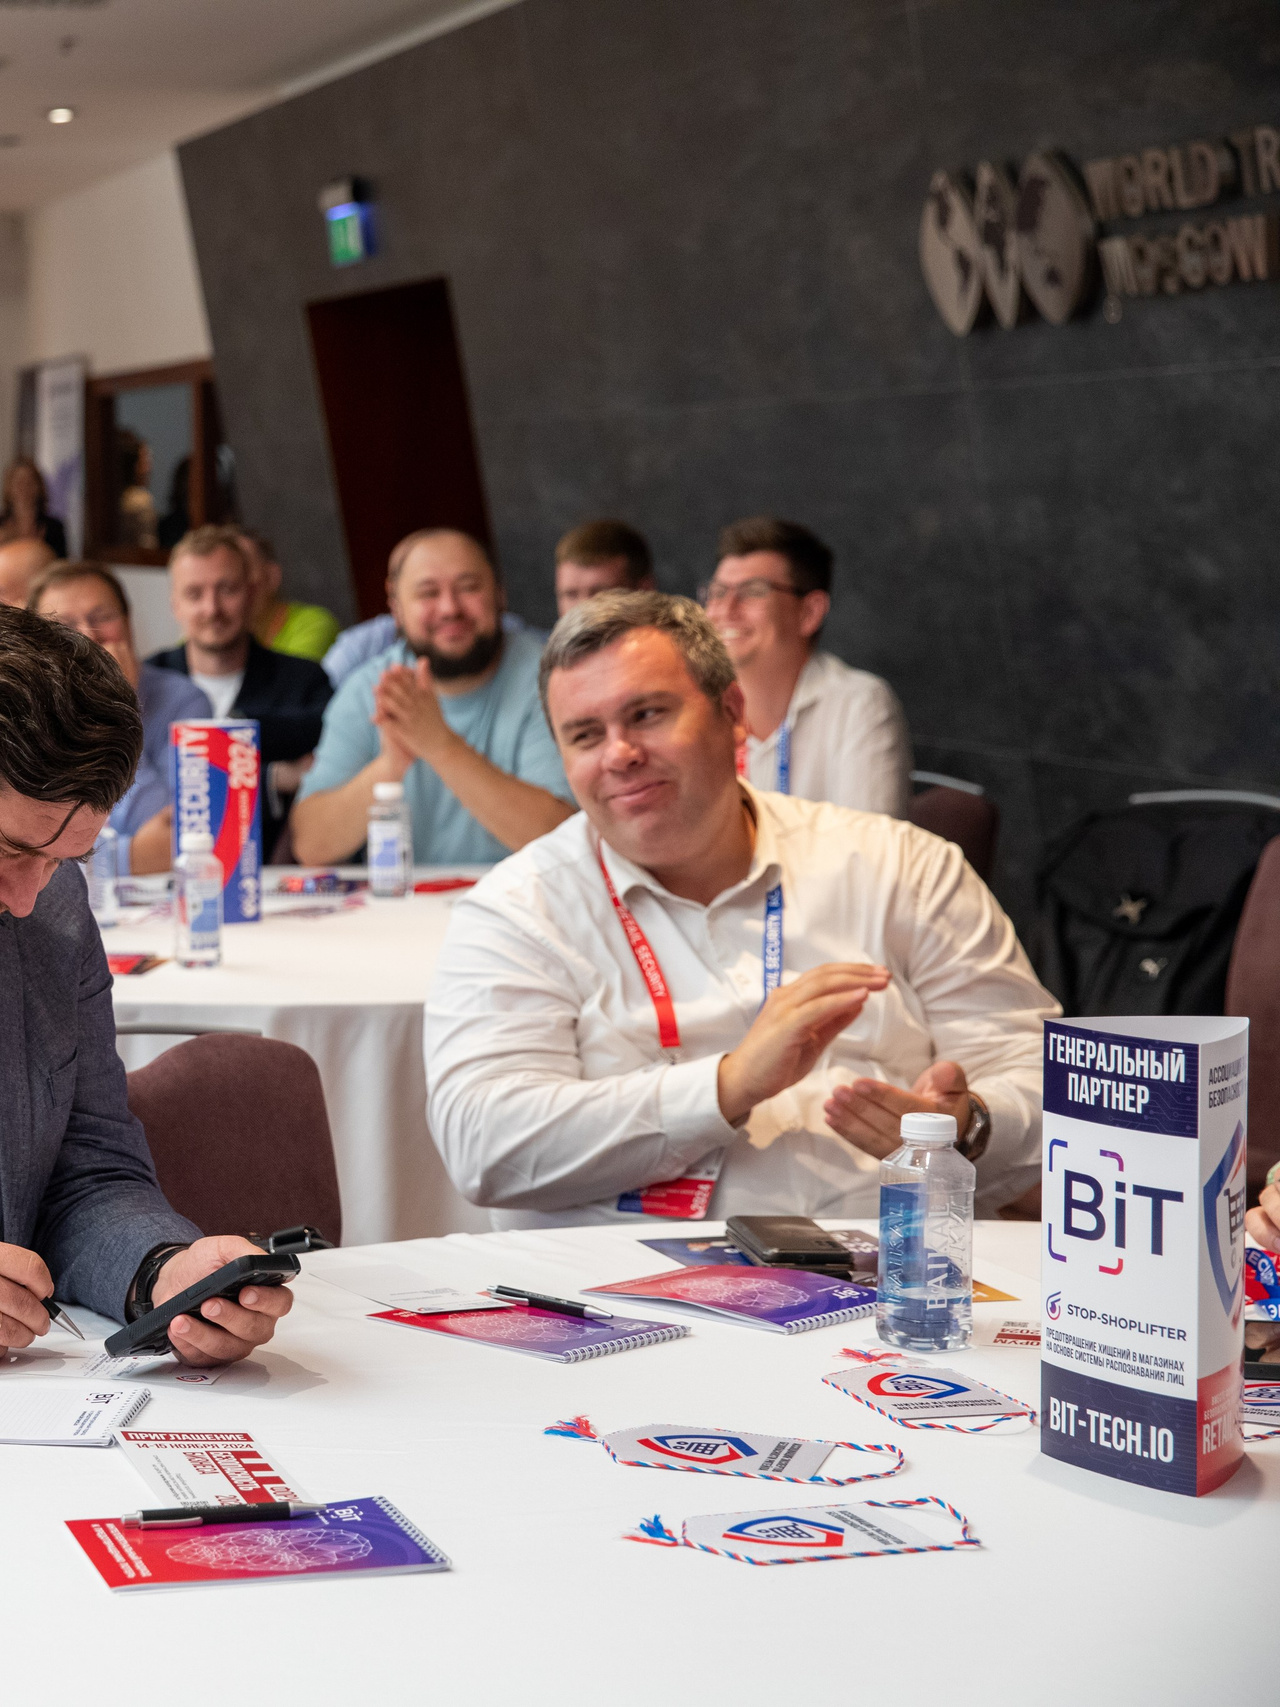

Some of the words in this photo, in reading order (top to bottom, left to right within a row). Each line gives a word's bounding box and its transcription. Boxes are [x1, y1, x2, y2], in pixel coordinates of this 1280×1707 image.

[1049, 1032, 1186, 1083] ГЕНЕРАЛЬНЫЙ
[1068, 1072, 1150, 1114] ПАРТНЕР
[926, 1202, 950, 1311] BAIKAL
[993, 1338, 1040, 1347] ОРУМ
[1067, 1304, 1187, 1341] STOP-SHOPLIFTER
[1046, 1327, 1097, 1351] ПРЕДОТВРАЩЕНИЕ
[1098, 1343, 1131, 1360] ХИЩЕНИЙ
[1132, 1352, 1137, 1362] В
[1138, 1353, 1185, 1372] МАГАЗИНАХ
[1046, 1340, 1053, 1351] НА
[1053, 1343, 1074, 1358] ОСНОВЕ
[1074, 1349, 1105, 1367] СИСТЕМЫ
[1105, 1357, 1165, 1382] РАСПОЗНАВАНИЯ
[1166, 1373, 1185, 1386] ЛИЦ
[127, 1432, 248, 1441] ПРИГЛАШЕНИЕ
[1049, 1396, 1174, 1463] BIT-TECH.IO
